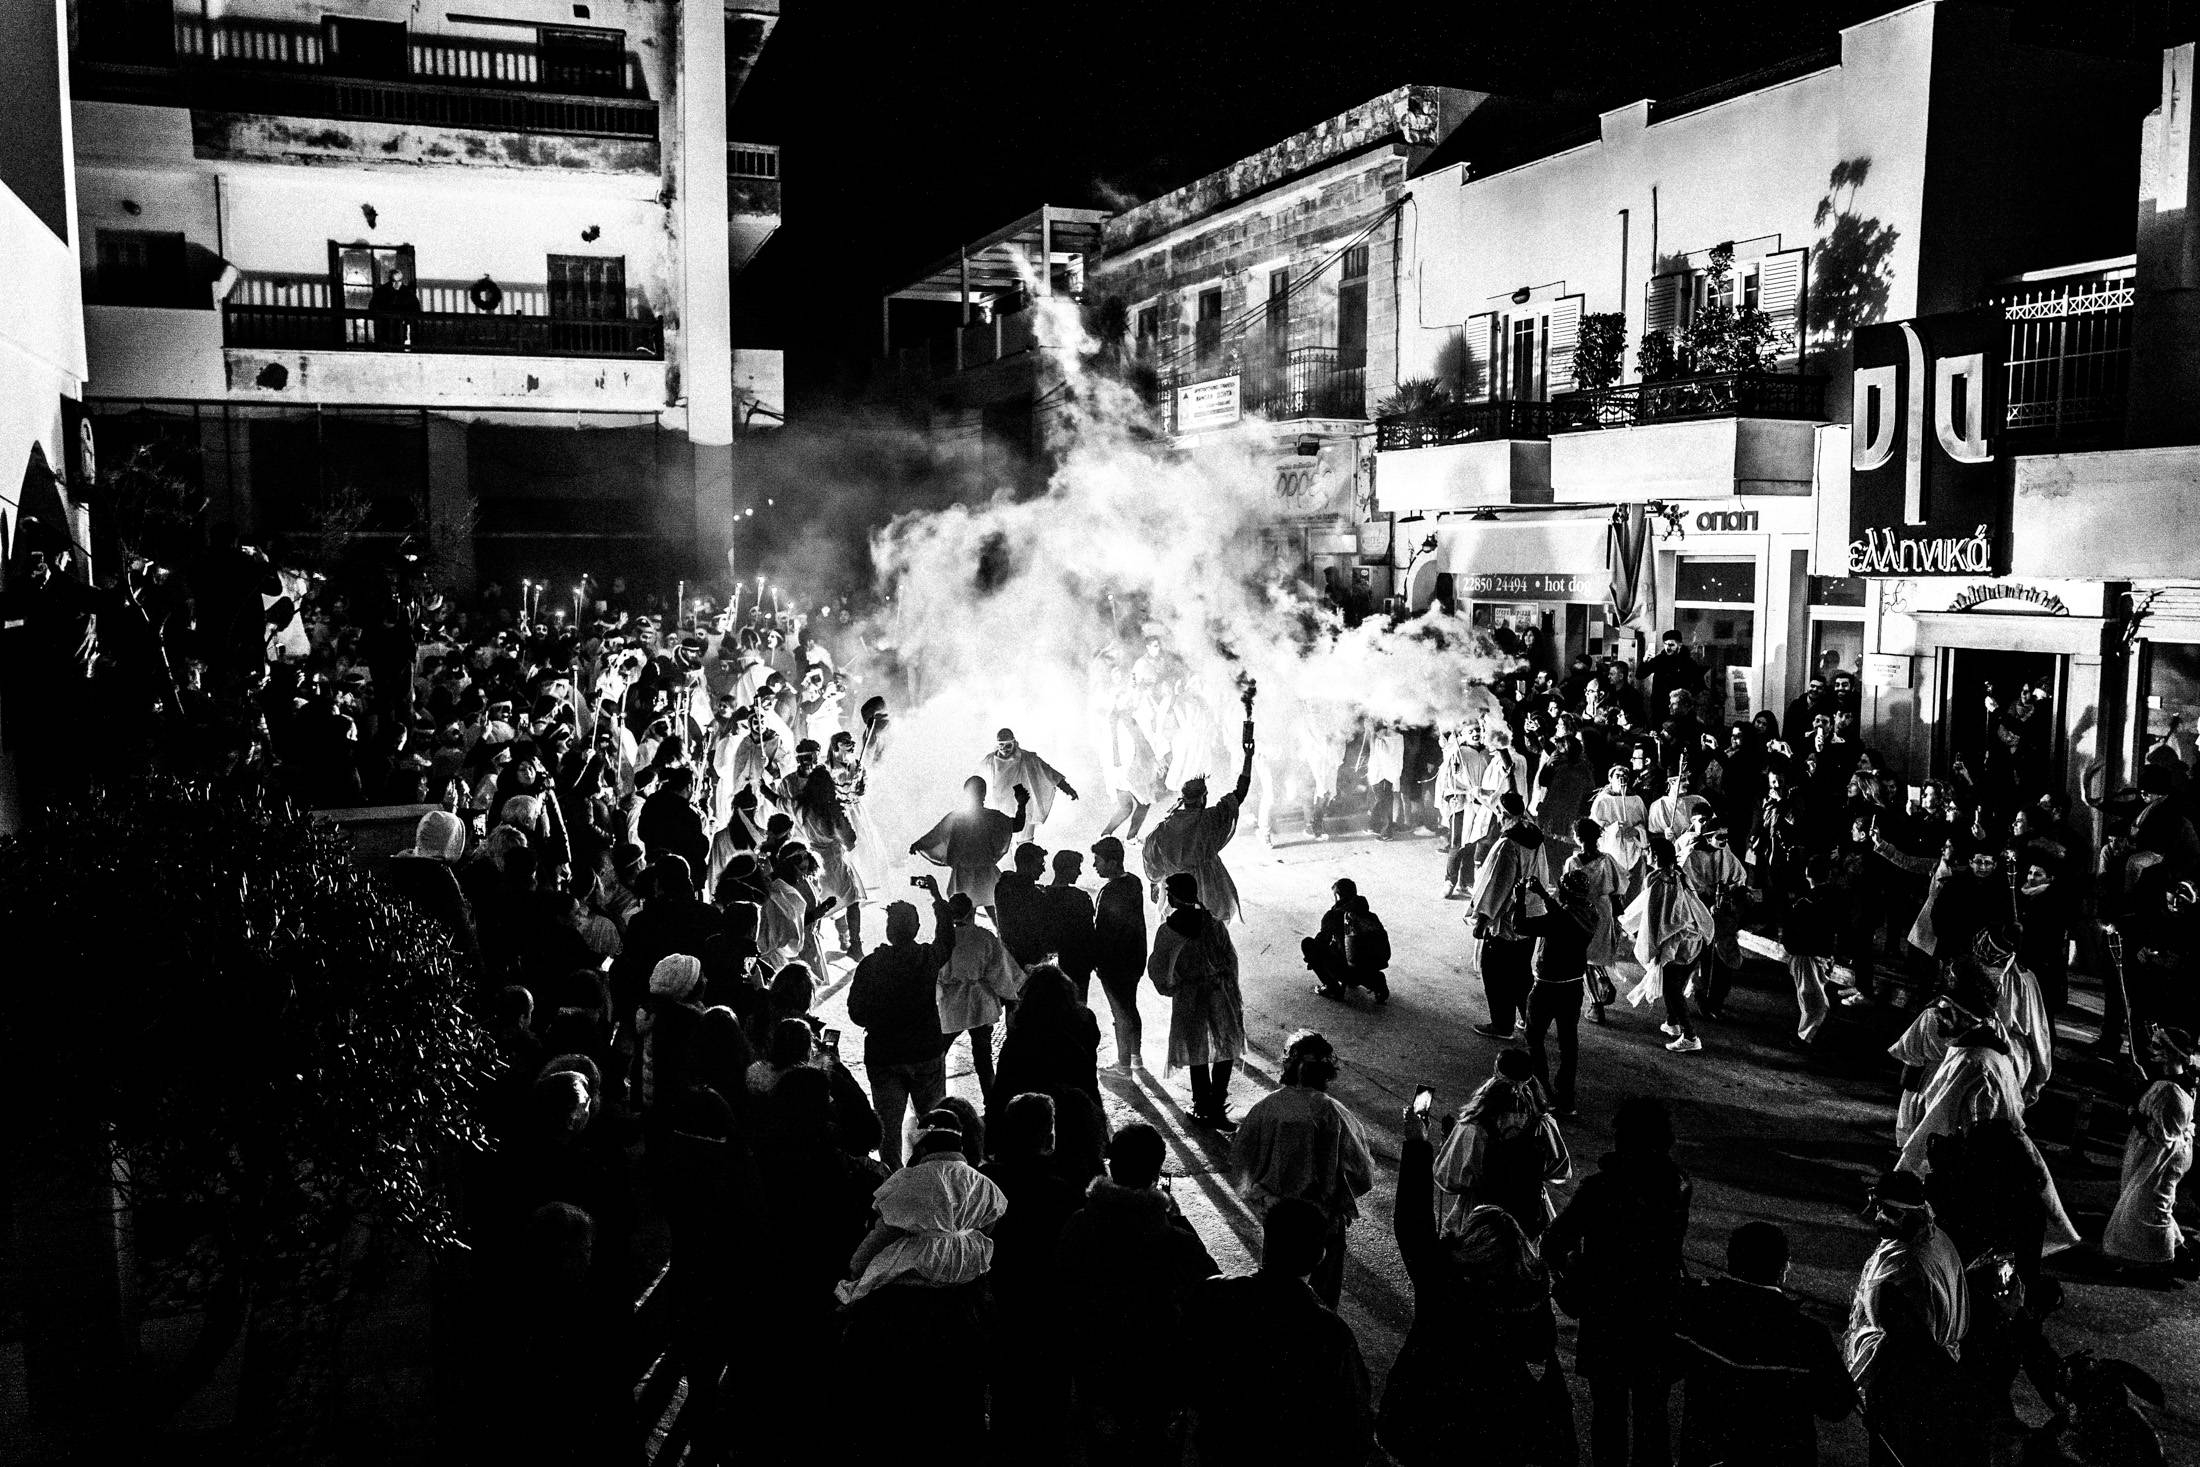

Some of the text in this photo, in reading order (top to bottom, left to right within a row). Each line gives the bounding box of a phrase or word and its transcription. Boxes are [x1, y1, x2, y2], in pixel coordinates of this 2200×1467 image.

[1849, 524, 1992, 574] ελληνικά
[1463, 576, 1493, 592] 22850
[1496, 575, 1528, 594] 24494
[1544, 575, 1565, 592] hot
